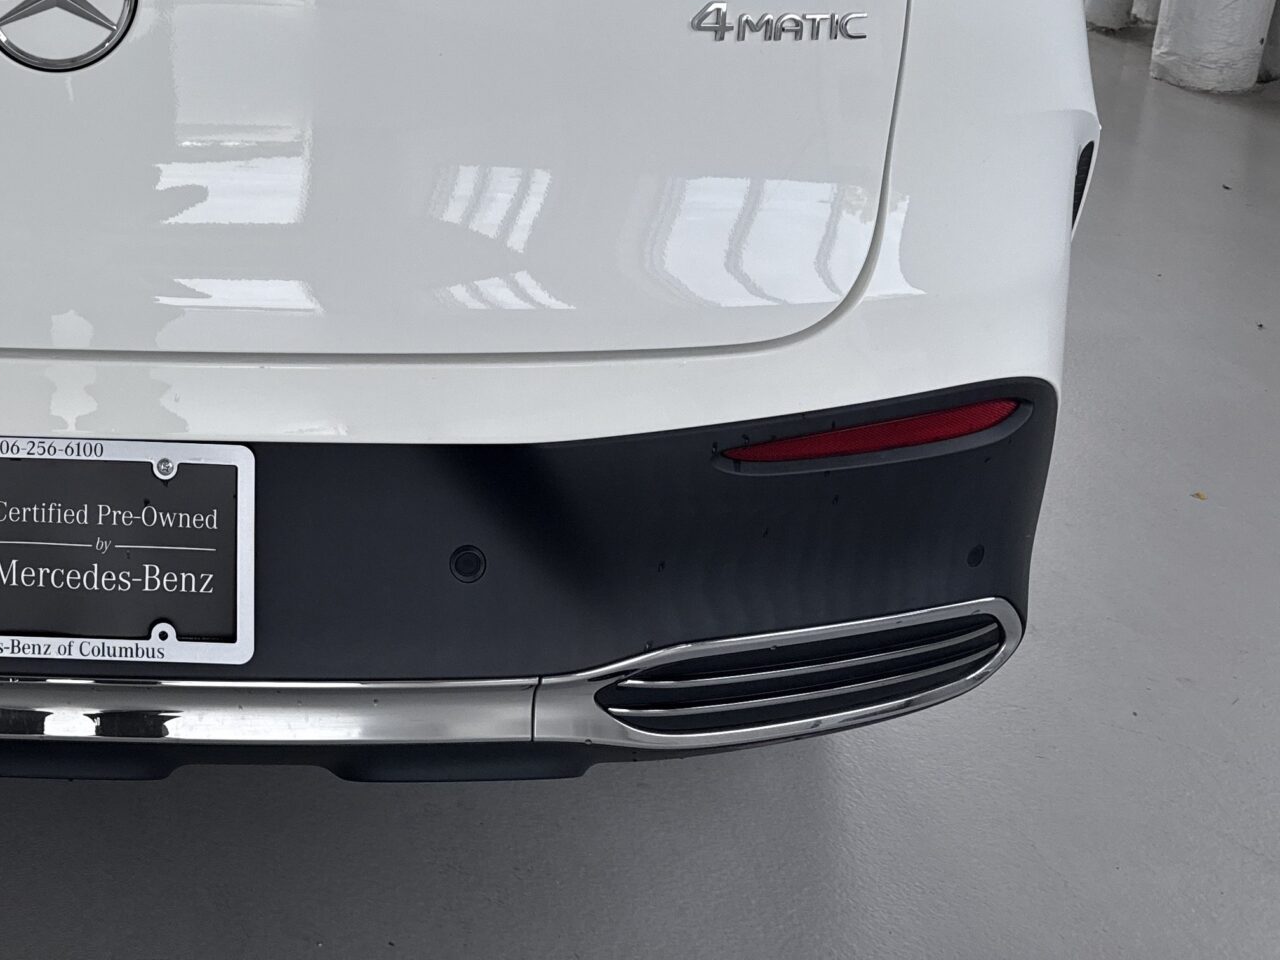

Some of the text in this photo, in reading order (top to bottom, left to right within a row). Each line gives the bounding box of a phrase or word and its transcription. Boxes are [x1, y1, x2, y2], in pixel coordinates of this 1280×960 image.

[690, 1, 867, 41] 4MATIC
[96, 503, 218, 530] Pre-Owned
[95, 537, 111, 554] by
[57, 641, 74, 657] of
[79, 643, 165, 660] Columbus
